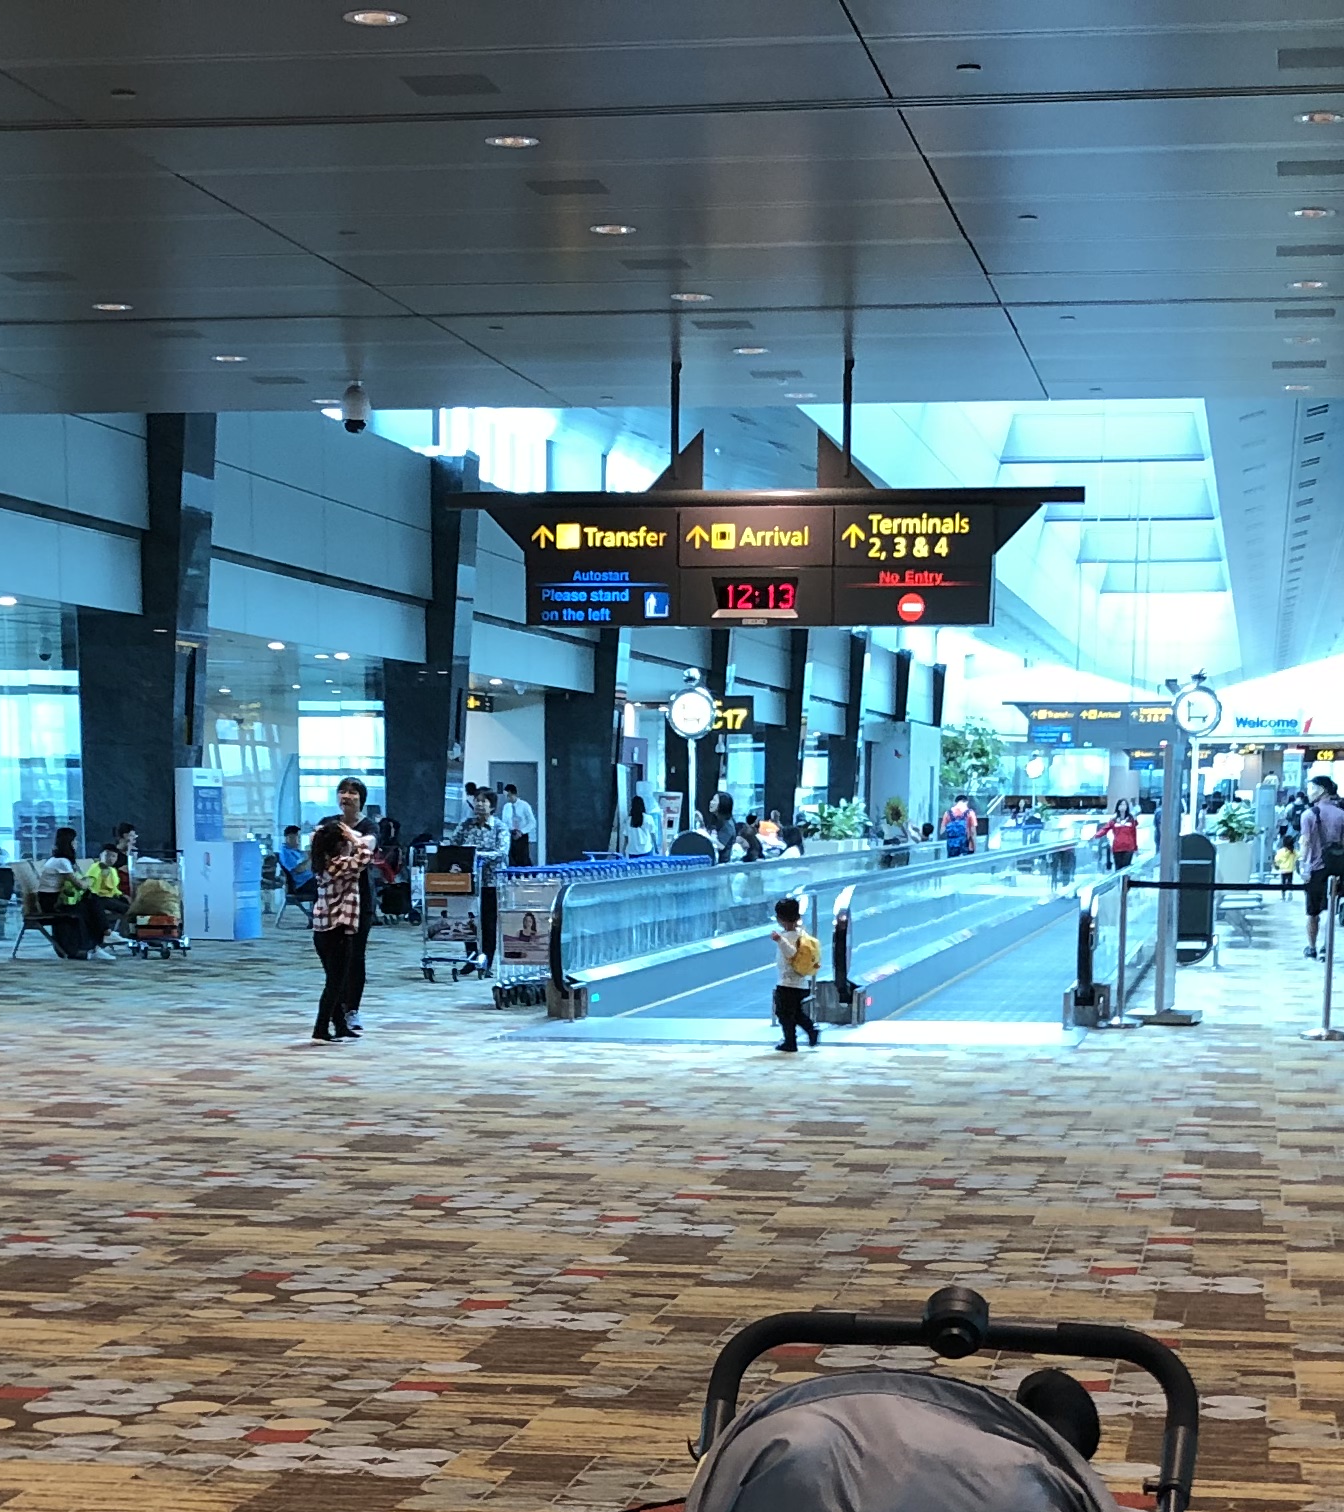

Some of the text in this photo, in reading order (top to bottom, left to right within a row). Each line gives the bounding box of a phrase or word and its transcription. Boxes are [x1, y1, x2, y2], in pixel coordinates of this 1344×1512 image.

[868, 512, 970, 534] Terminals
[583, 526, 667, 547] Transfer
[739, 525, 809, 546] Arrival
[868, 536, 948, 560] 2, 3 & 4
[573, 570, 629, 581] Autostart
[879, 570, 944, 585] No Entry
[542, 588, 629, 601] Please stand
[727, 583, 795, 609] 12:13
[541, 608, 611, 621] on the left
[712, 708, 748, 730] C17
[1236, 716, 1298, 728] Welcome
